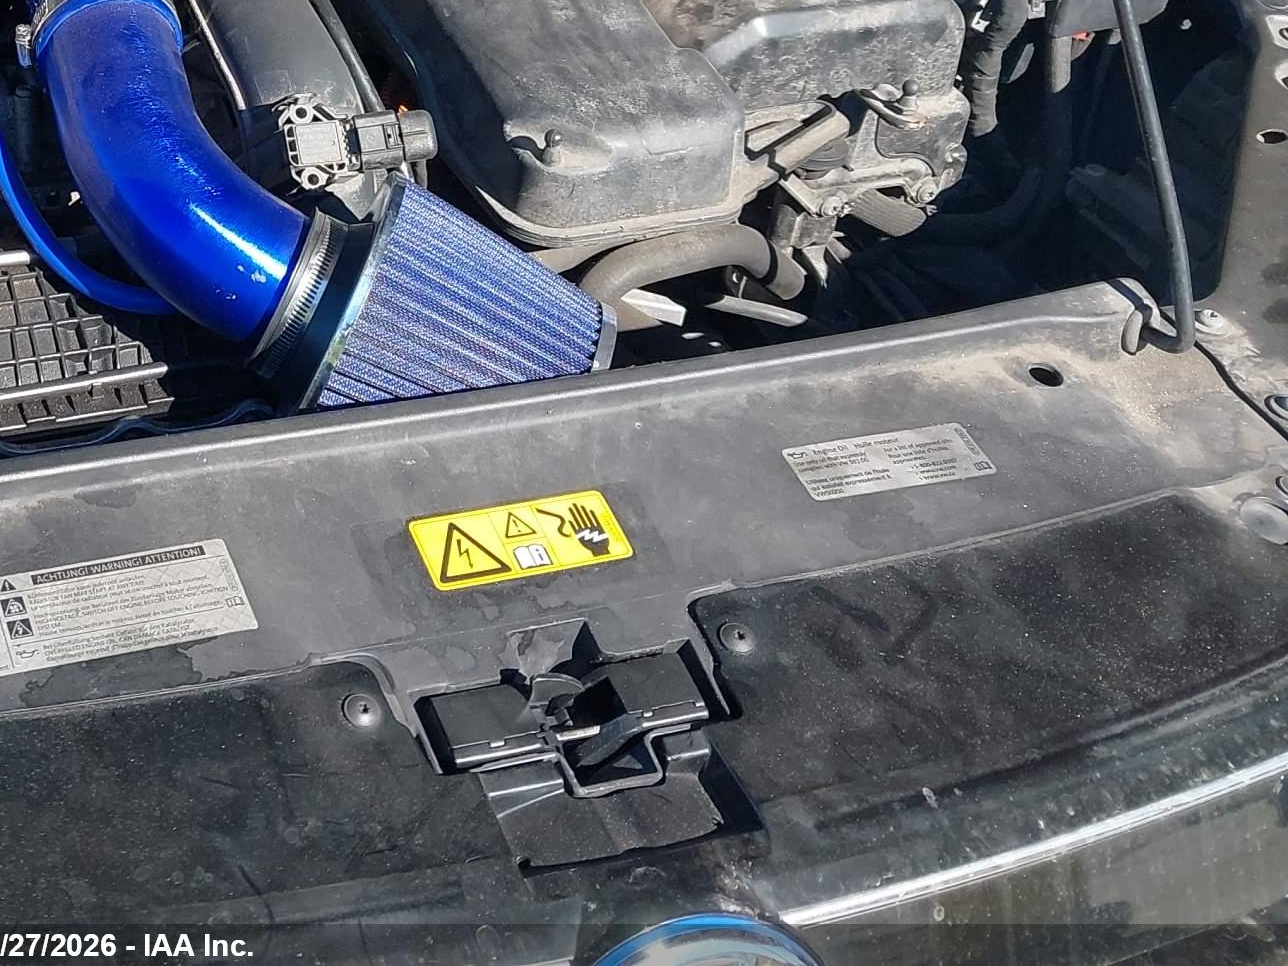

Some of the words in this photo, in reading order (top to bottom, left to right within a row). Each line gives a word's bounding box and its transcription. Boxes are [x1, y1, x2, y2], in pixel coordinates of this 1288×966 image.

[38, 568, 88, 582] ACHTUNG!
[91, 558, 142, 572] WARNING!
[146, 548, 200, 563] ATTENTION!
